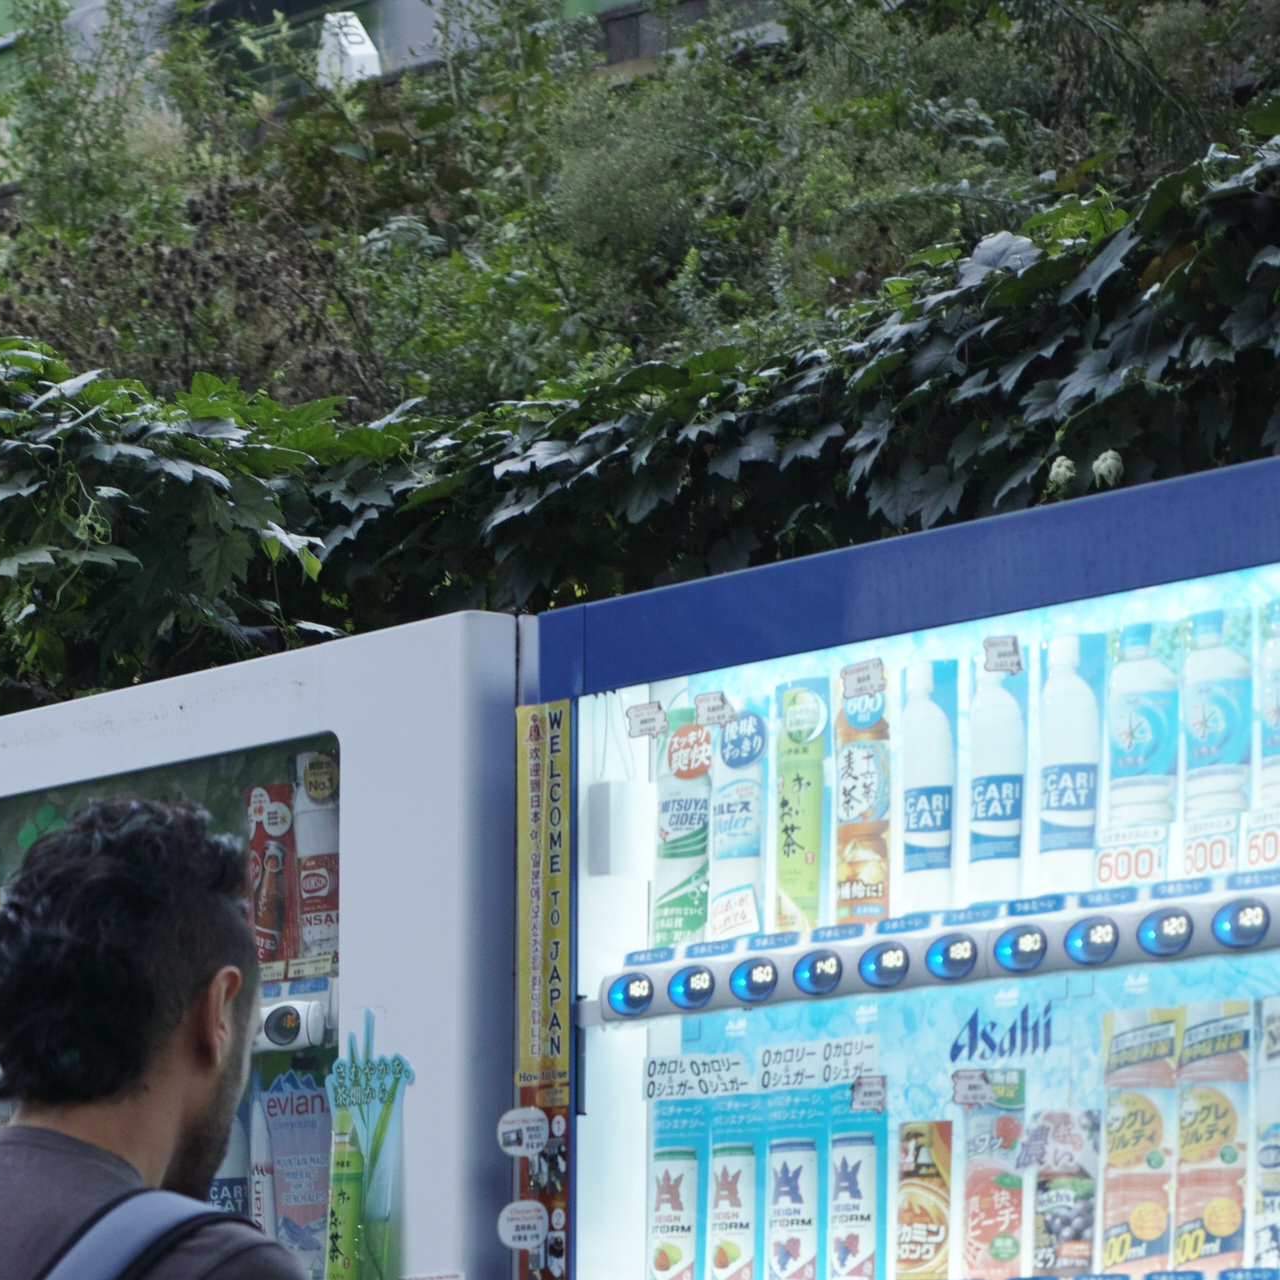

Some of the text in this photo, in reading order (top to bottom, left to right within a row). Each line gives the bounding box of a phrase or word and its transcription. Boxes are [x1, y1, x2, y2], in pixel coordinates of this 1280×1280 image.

[846, 696, 881, 714] 600
[724, 717, 758, 741] 後味
[671, 728, 706, 750] スッキリ
[723, 738, 762, 761] すっきり
[671, 746, 712, 773] 爽快
[308, 777, 333, 792] No.1
[1041, 772, 1094, 791] CARI
[971, 782, 1020, 801] CARI
[906, 794, 949, 814] CARI
[670, 808, 706, 825] CIDER
[1185, 839, 1227, 876] 600
[1247, 831, 1280, 865] 60
[1098, 849, 1153, 883] 600
[548, 710, 563, 1056] WELCOME TO JAPAN
[816, 957, 837, 974] 140
[950, 1001, 1053, 1063] Asahi
[762, 1046, 816, 1067] 0カロリー
[823, 1040, 874, 1061] 0カロリー
[335, 1057, 410, 1083] さわやかを、
[519, 1069, 567, 1083] How to Use
[690, 1057, 741, 1076] 0カロリー
[822, 1063, 873, 1083] 0シュガー
[698, 1076, 748, 1094] 0シュガー
[761, 1069, 815, 1088] 0シュガー
[646, 1080, 694, 1098] 0シュガー
[556, 1118, 562, 1133] 1
[285, 1170, 318, 1181] MINERALS
[554, 1212, 563, 1226] 2
